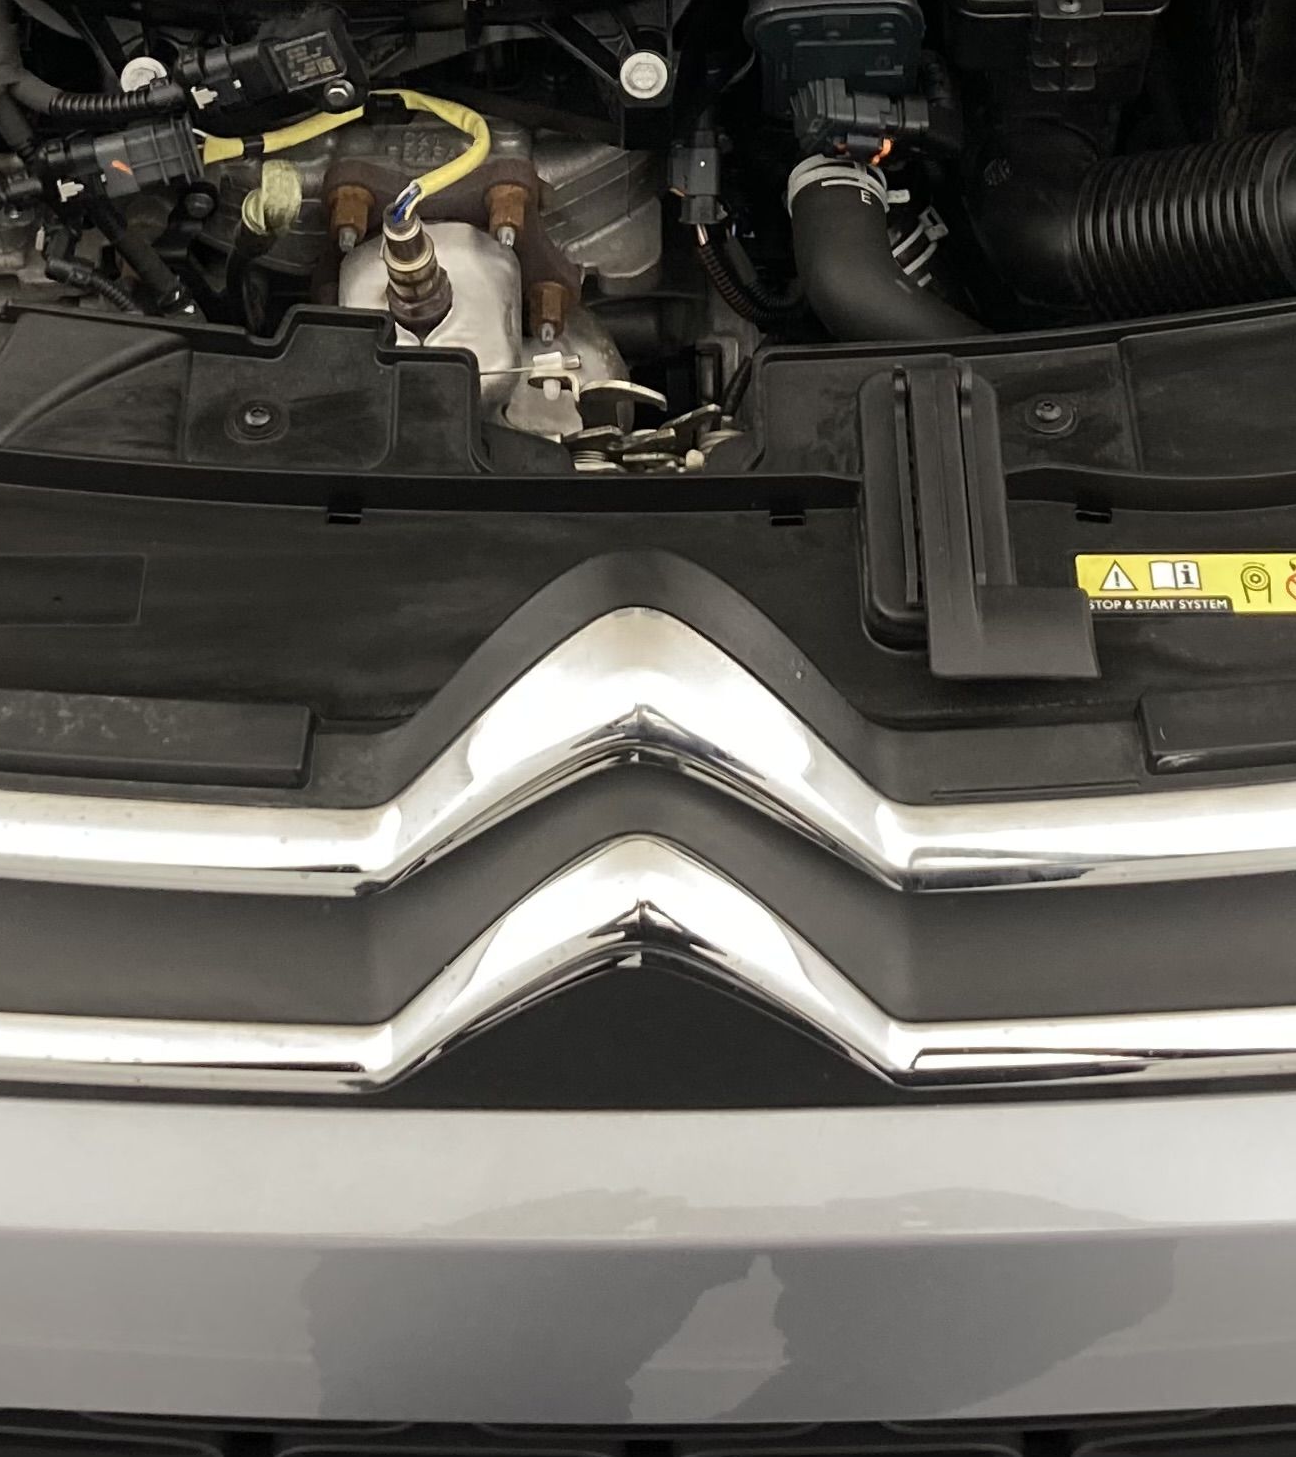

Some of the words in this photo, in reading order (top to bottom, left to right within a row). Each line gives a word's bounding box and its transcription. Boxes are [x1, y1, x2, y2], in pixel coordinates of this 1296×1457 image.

[1089, 599, 1122, 610] STOP
[1124, 599, 1133, 610] &
[1136, 599, 1175, 610] START
[1179, 599, 1228, 610] SYSTEM
